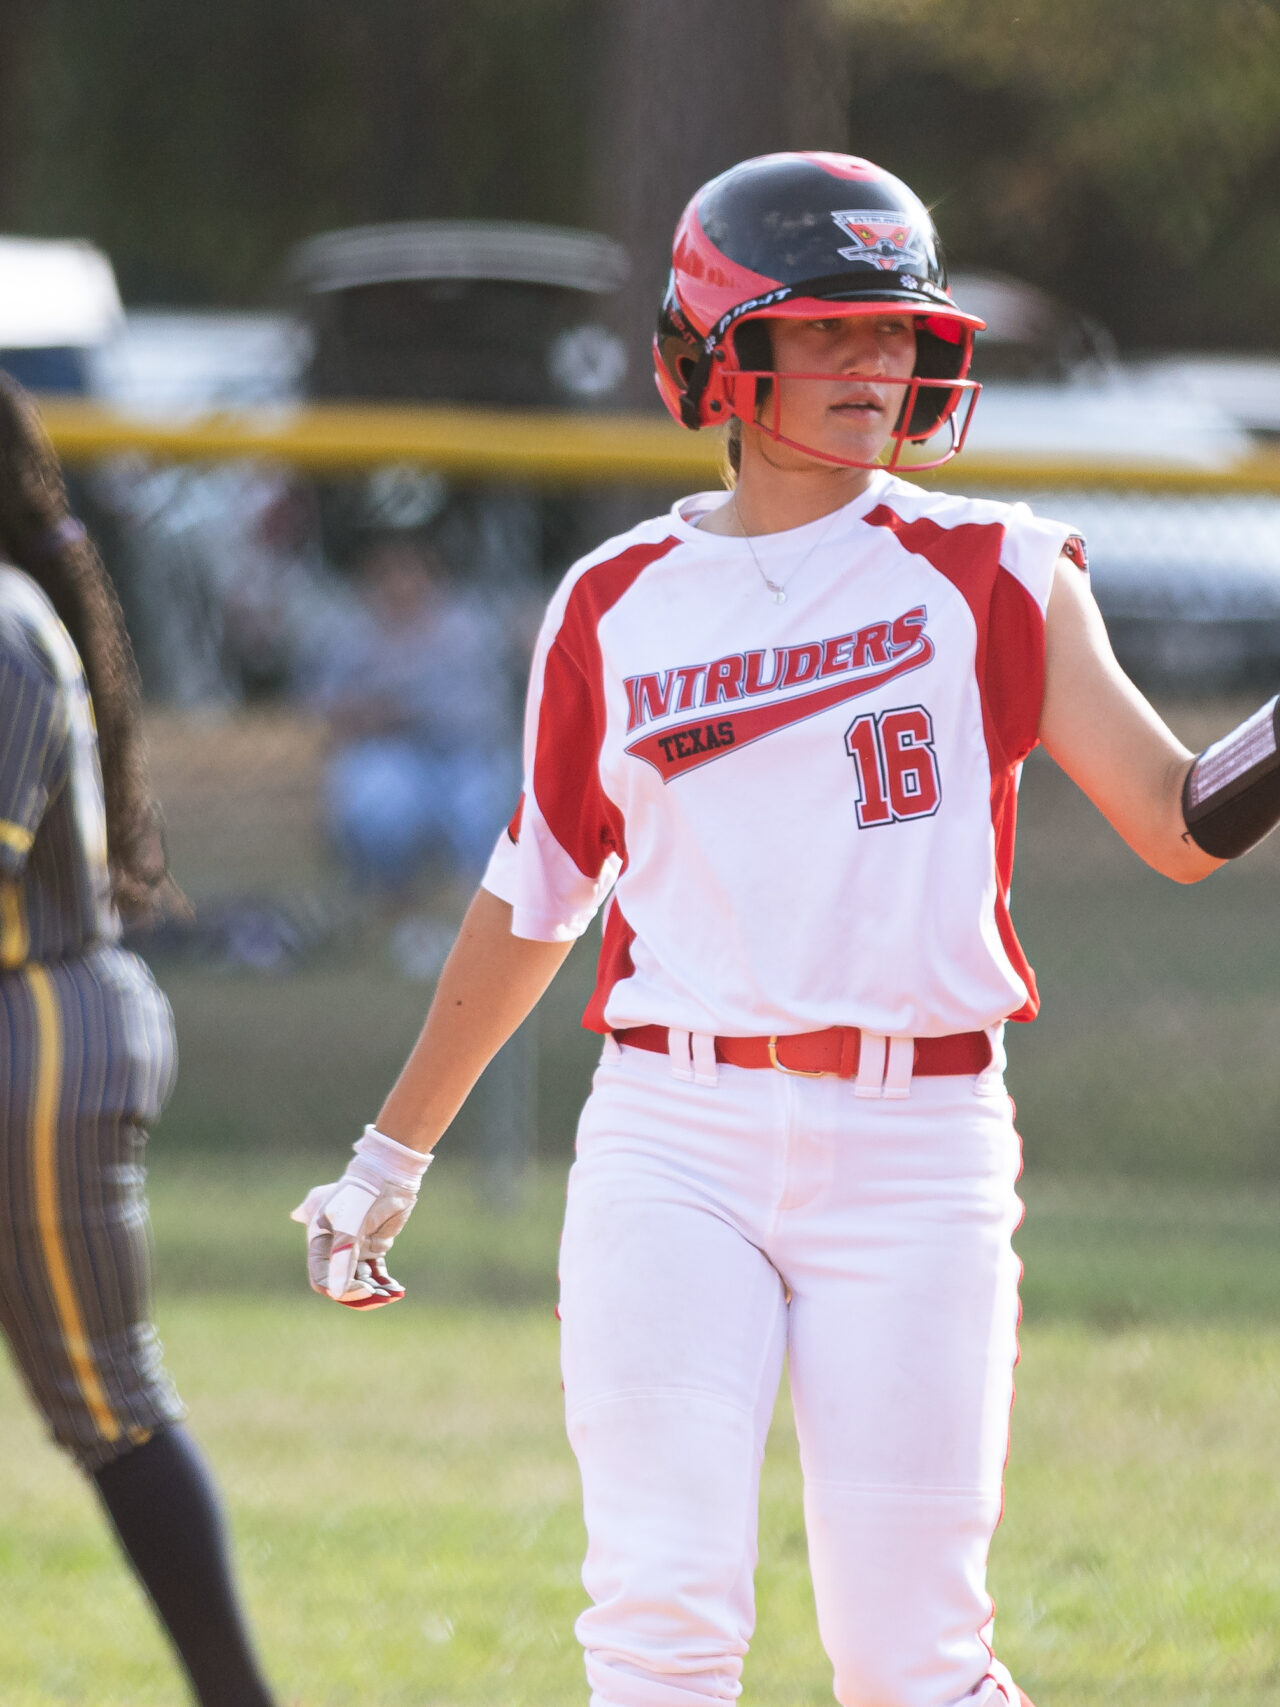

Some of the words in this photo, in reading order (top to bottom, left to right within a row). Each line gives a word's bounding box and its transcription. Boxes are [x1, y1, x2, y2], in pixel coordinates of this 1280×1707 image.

[622, 604, 928, 735] INTRUDERS
[657, 720, 736, 763] TEXAS
[844, 703, 942, 830] 16
